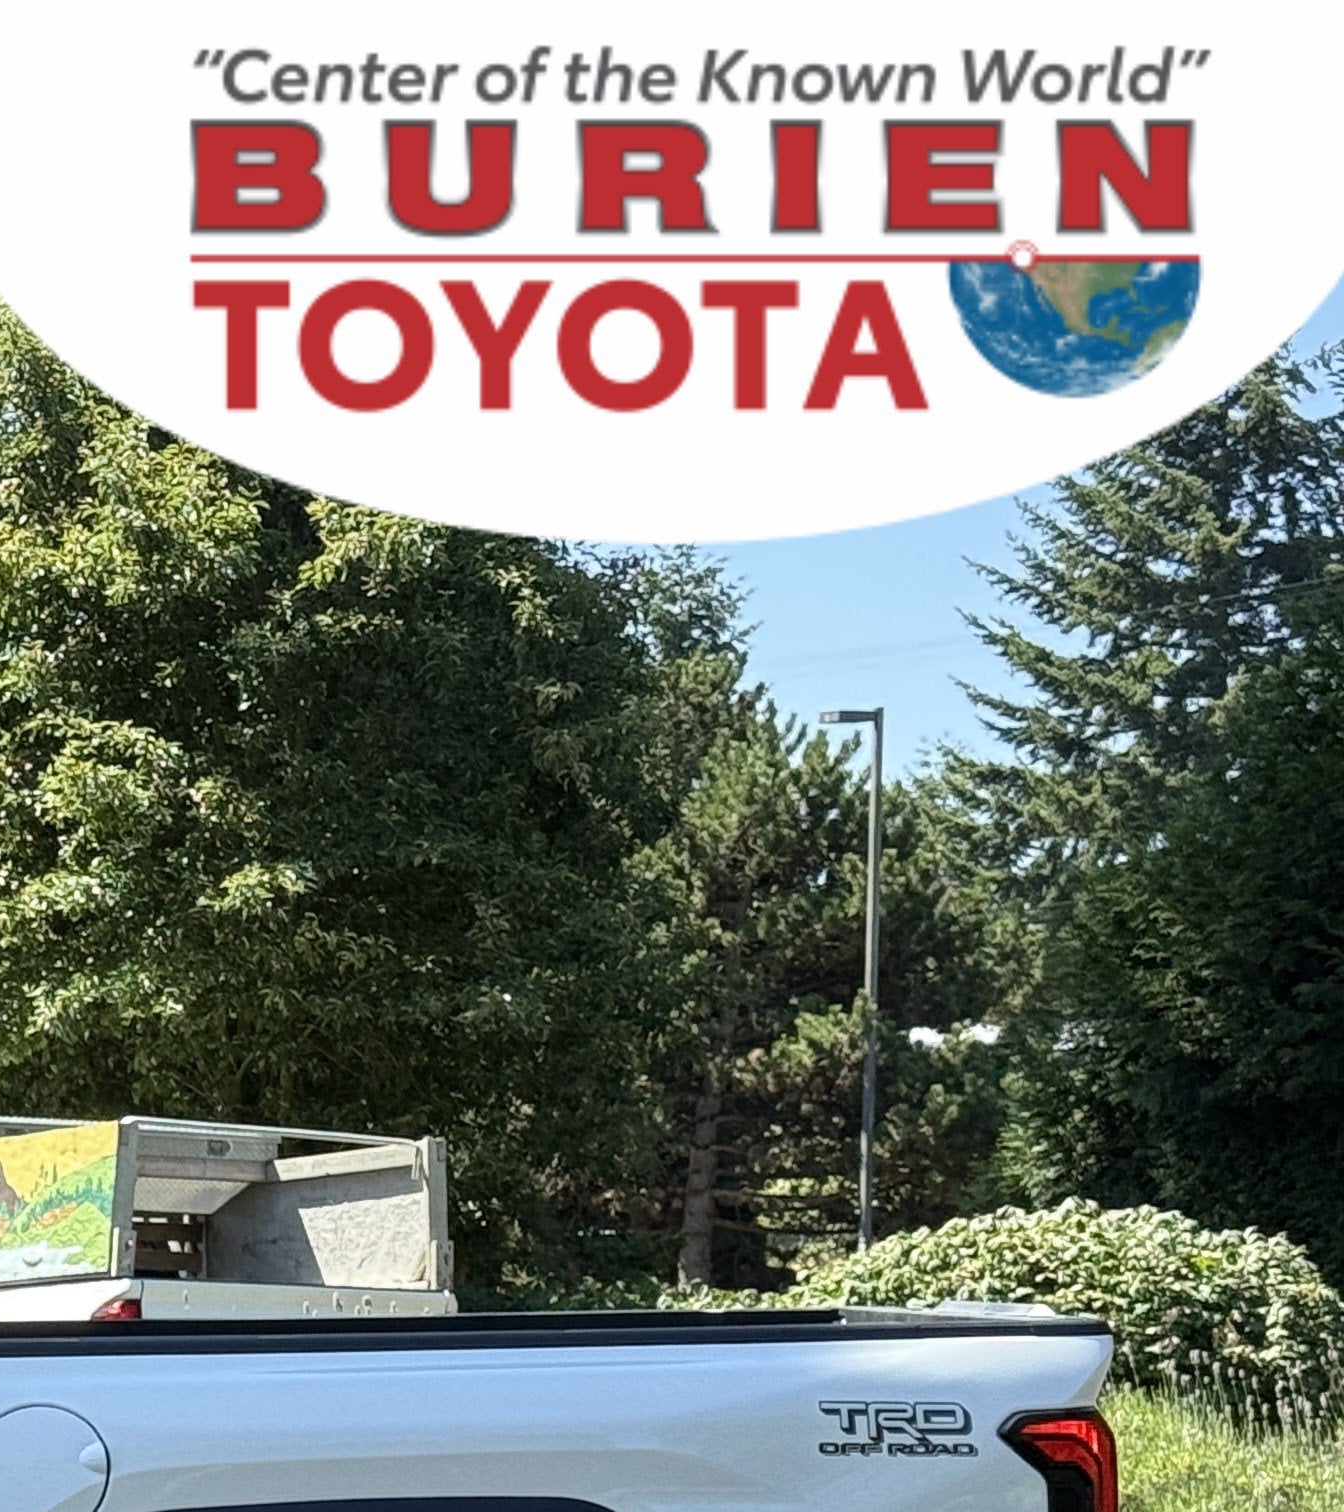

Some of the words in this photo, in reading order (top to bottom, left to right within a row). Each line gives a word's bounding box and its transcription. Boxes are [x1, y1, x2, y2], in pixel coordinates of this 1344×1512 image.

[819, 1400, 973, 1445] TRD
[819, 1442, 883, 1457] OFF
[887, 1443, 979, 1457] ROAD
